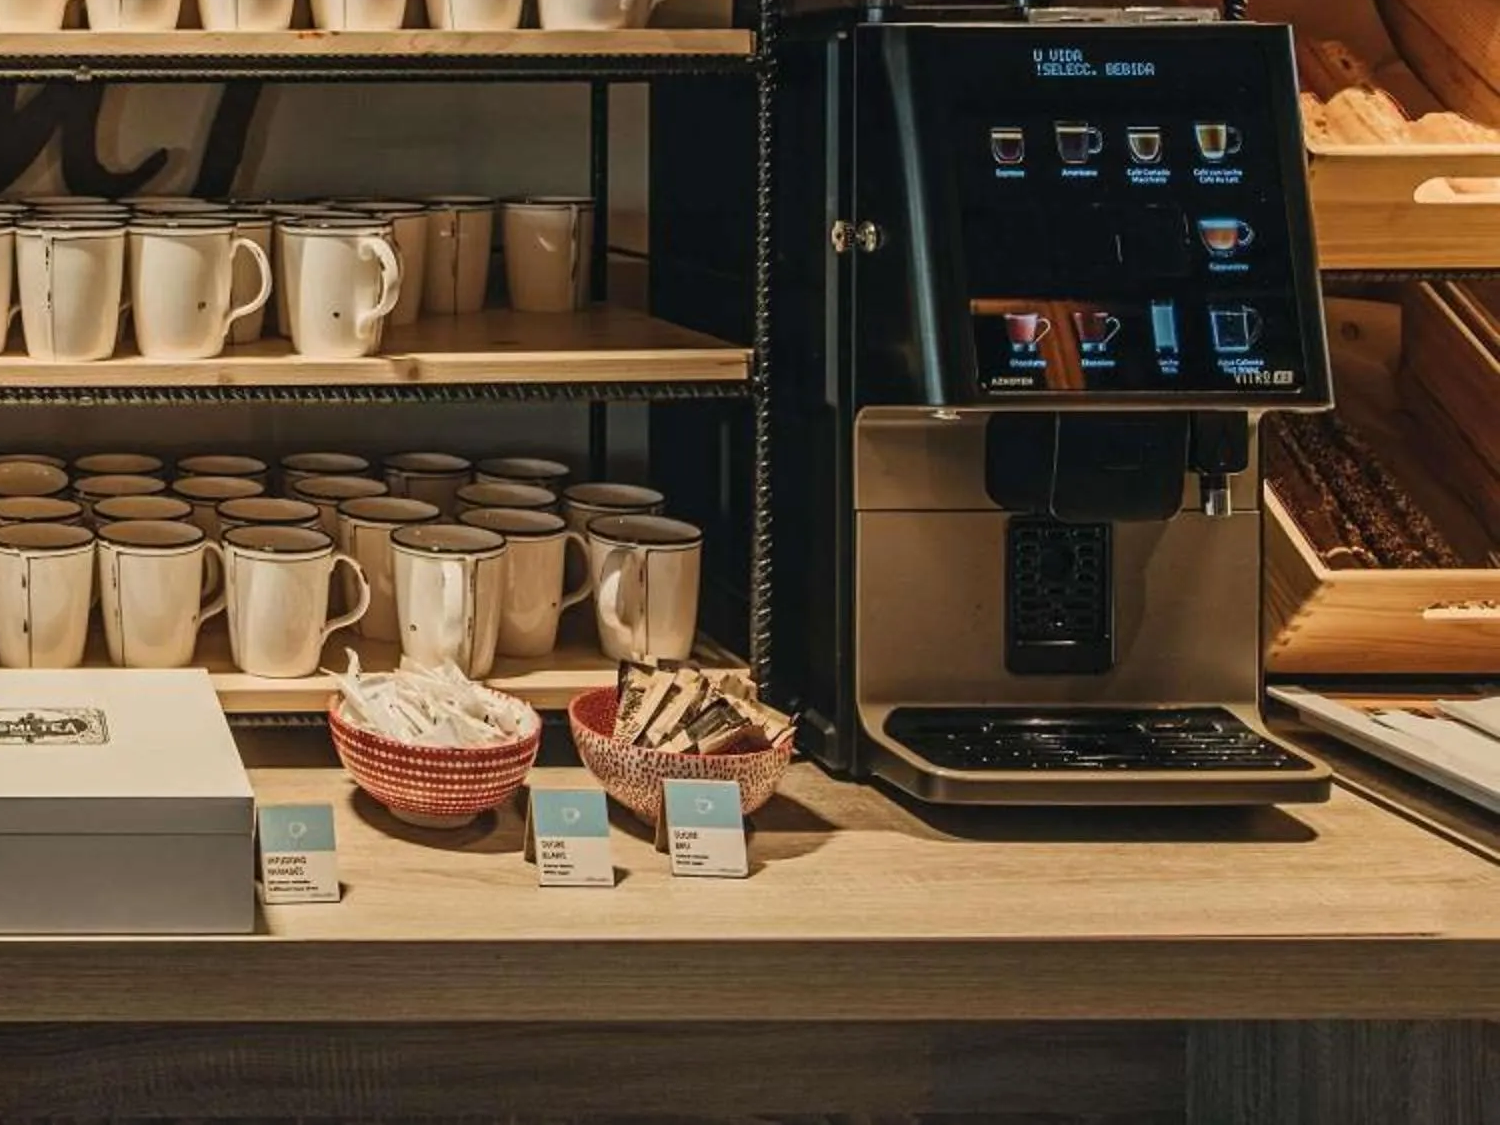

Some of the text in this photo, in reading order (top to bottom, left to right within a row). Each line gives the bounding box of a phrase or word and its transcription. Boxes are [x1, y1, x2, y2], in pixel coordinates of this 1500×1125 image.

[1049, 48, 1083, 62] VIDA
[1105, 62, 1156, 76] BEBIDA
[36, 721, 77, 733] TEA
